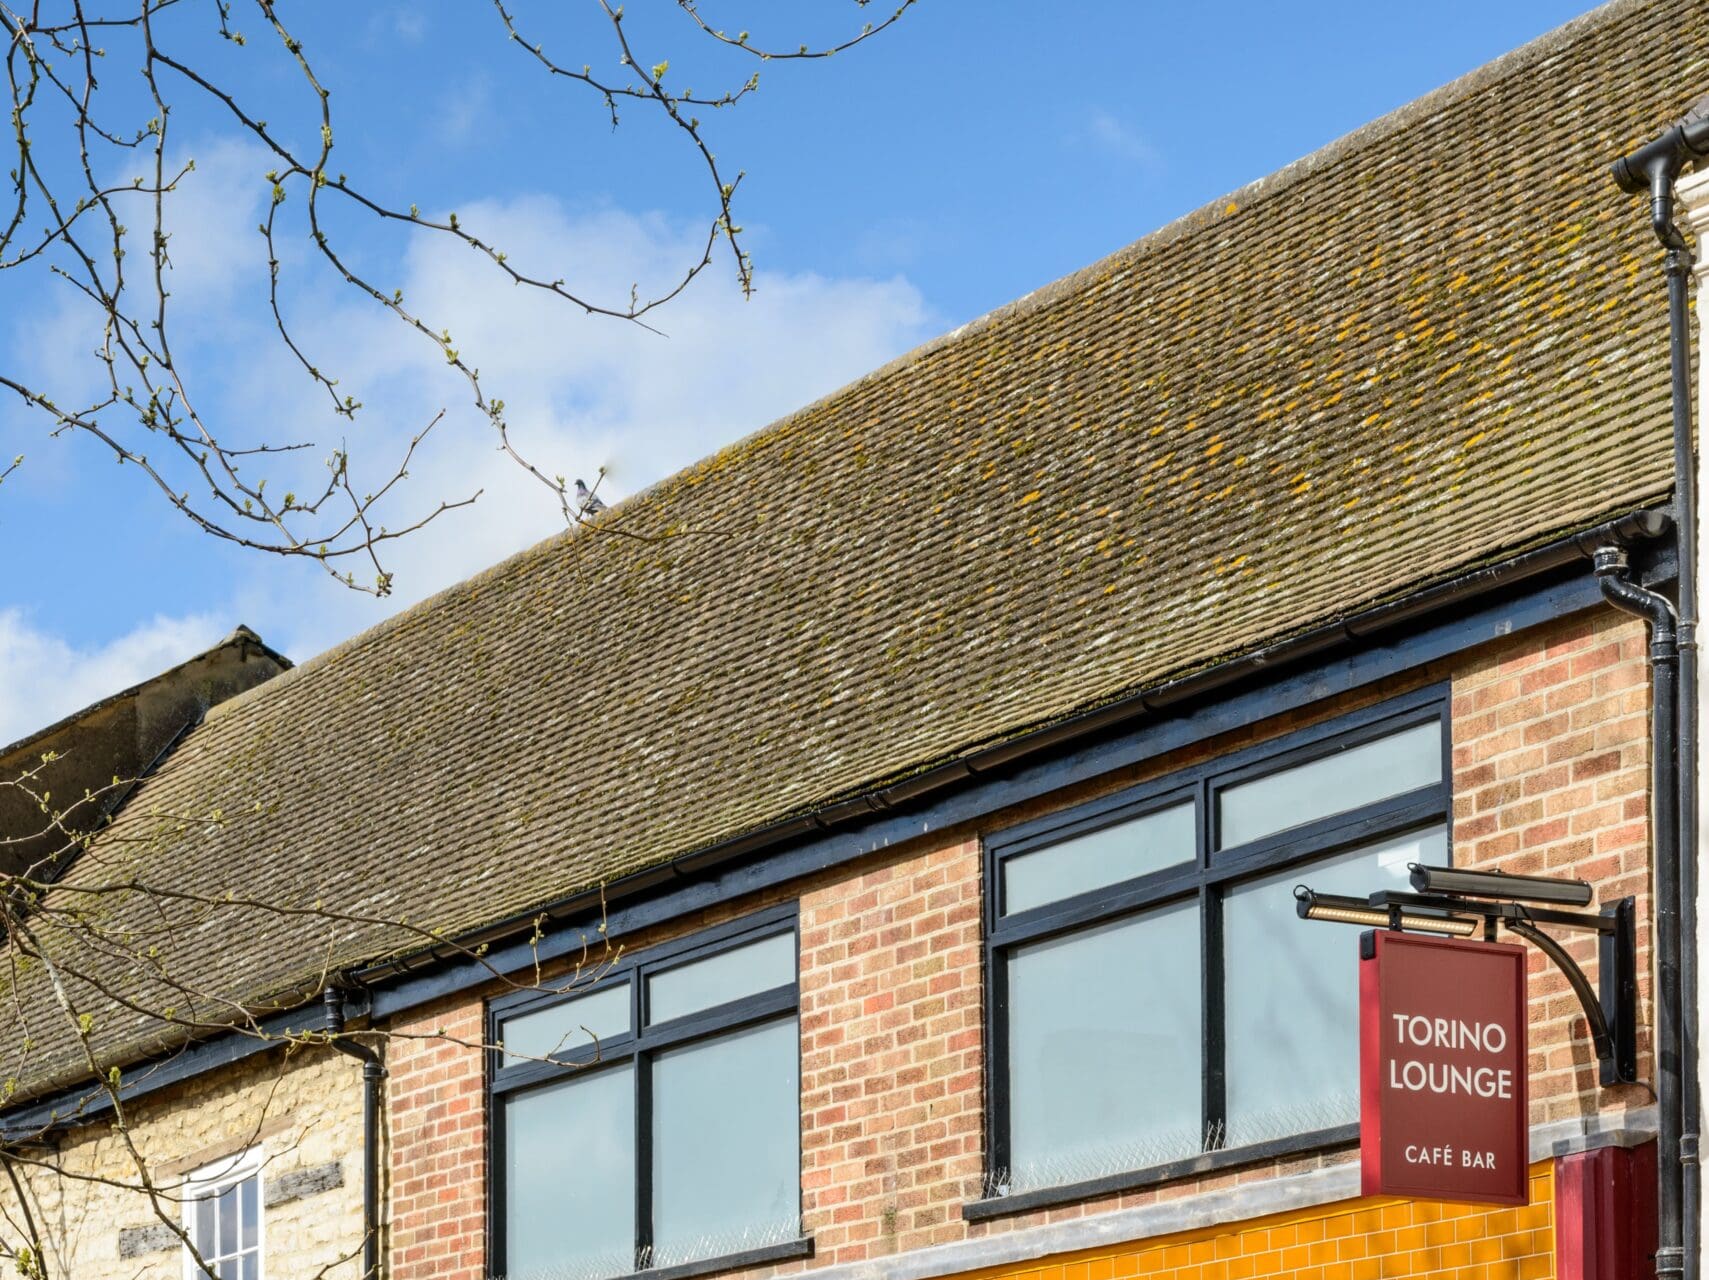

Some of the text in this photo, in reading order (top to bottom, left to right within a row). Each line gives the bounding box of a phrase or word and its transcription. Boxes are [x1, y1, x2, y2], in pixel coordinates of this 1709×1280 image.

[1392, 1013, 1507, 1053] TORINO
[1390, 1059, 1512, 1099] LOUNGE
[1405, 1144, 1496, 1169] CAFÉ BAR
